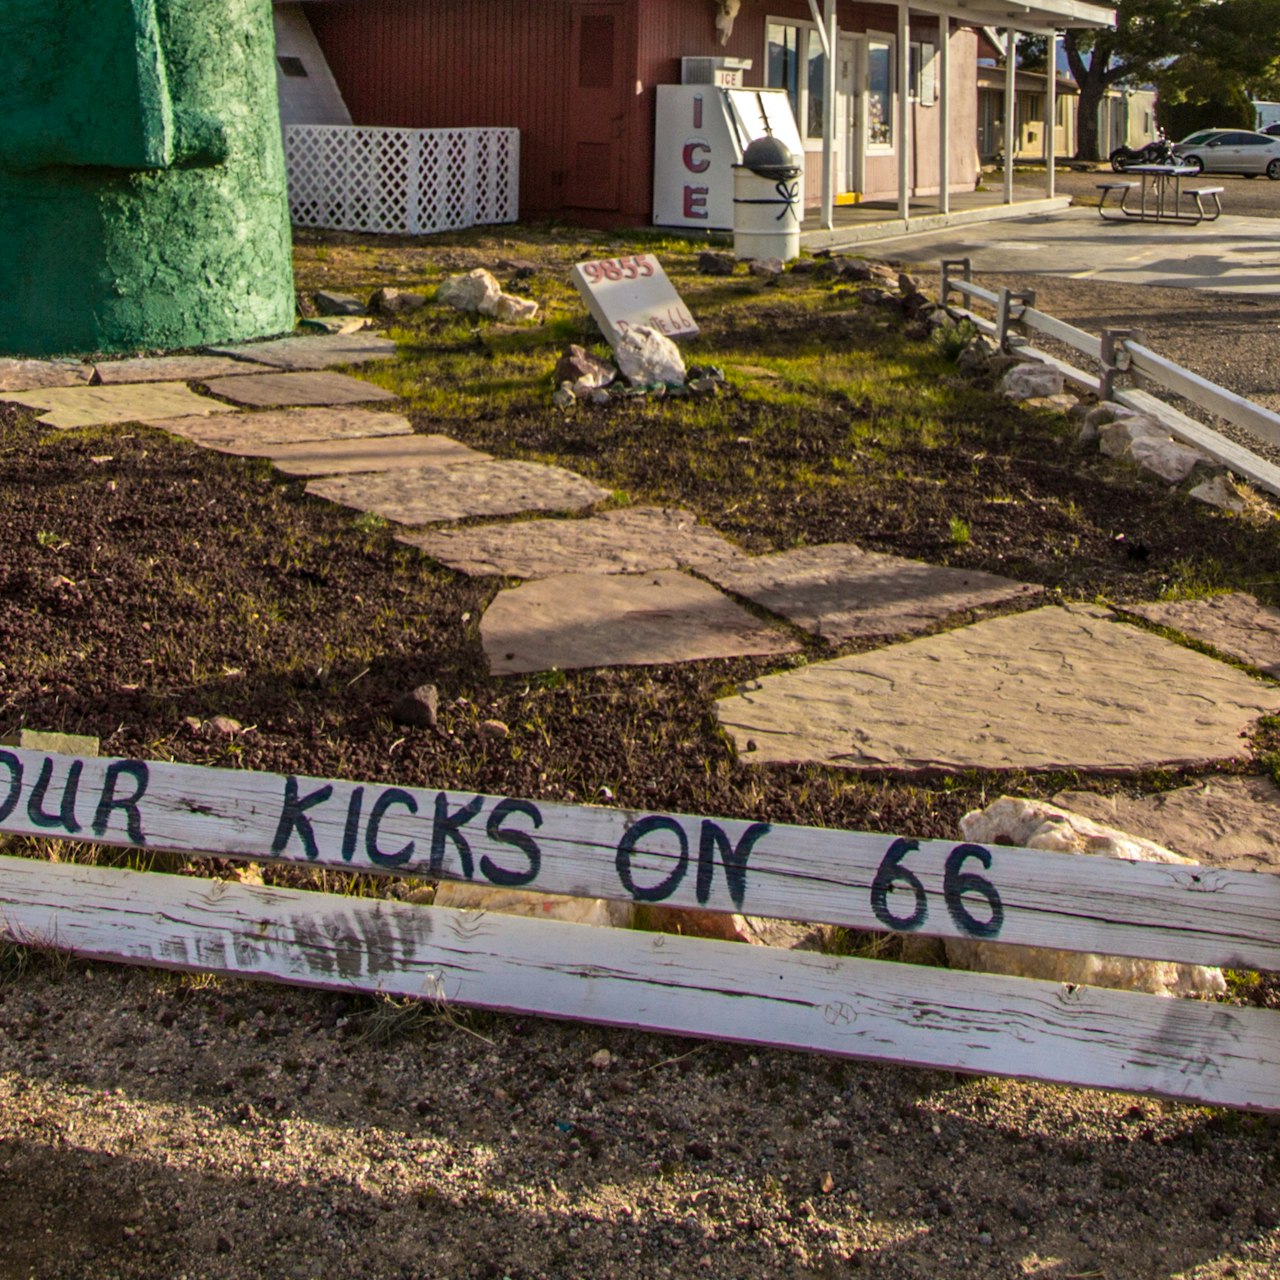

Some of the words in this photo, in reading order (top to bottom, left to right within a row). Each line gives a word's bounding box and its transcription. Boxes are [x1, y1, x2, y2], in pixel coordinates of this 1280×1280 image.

[721, 73, 736, 86] ICE
[682, 93, 711, 219] ICE
[584, 254, 654, 283] 9855
[668, 307, 691, 330] 66
[270, 775, 544, 887] KICKS
[614, 813, 772, 911] ON
[870, 837, 1005, 938] 66
